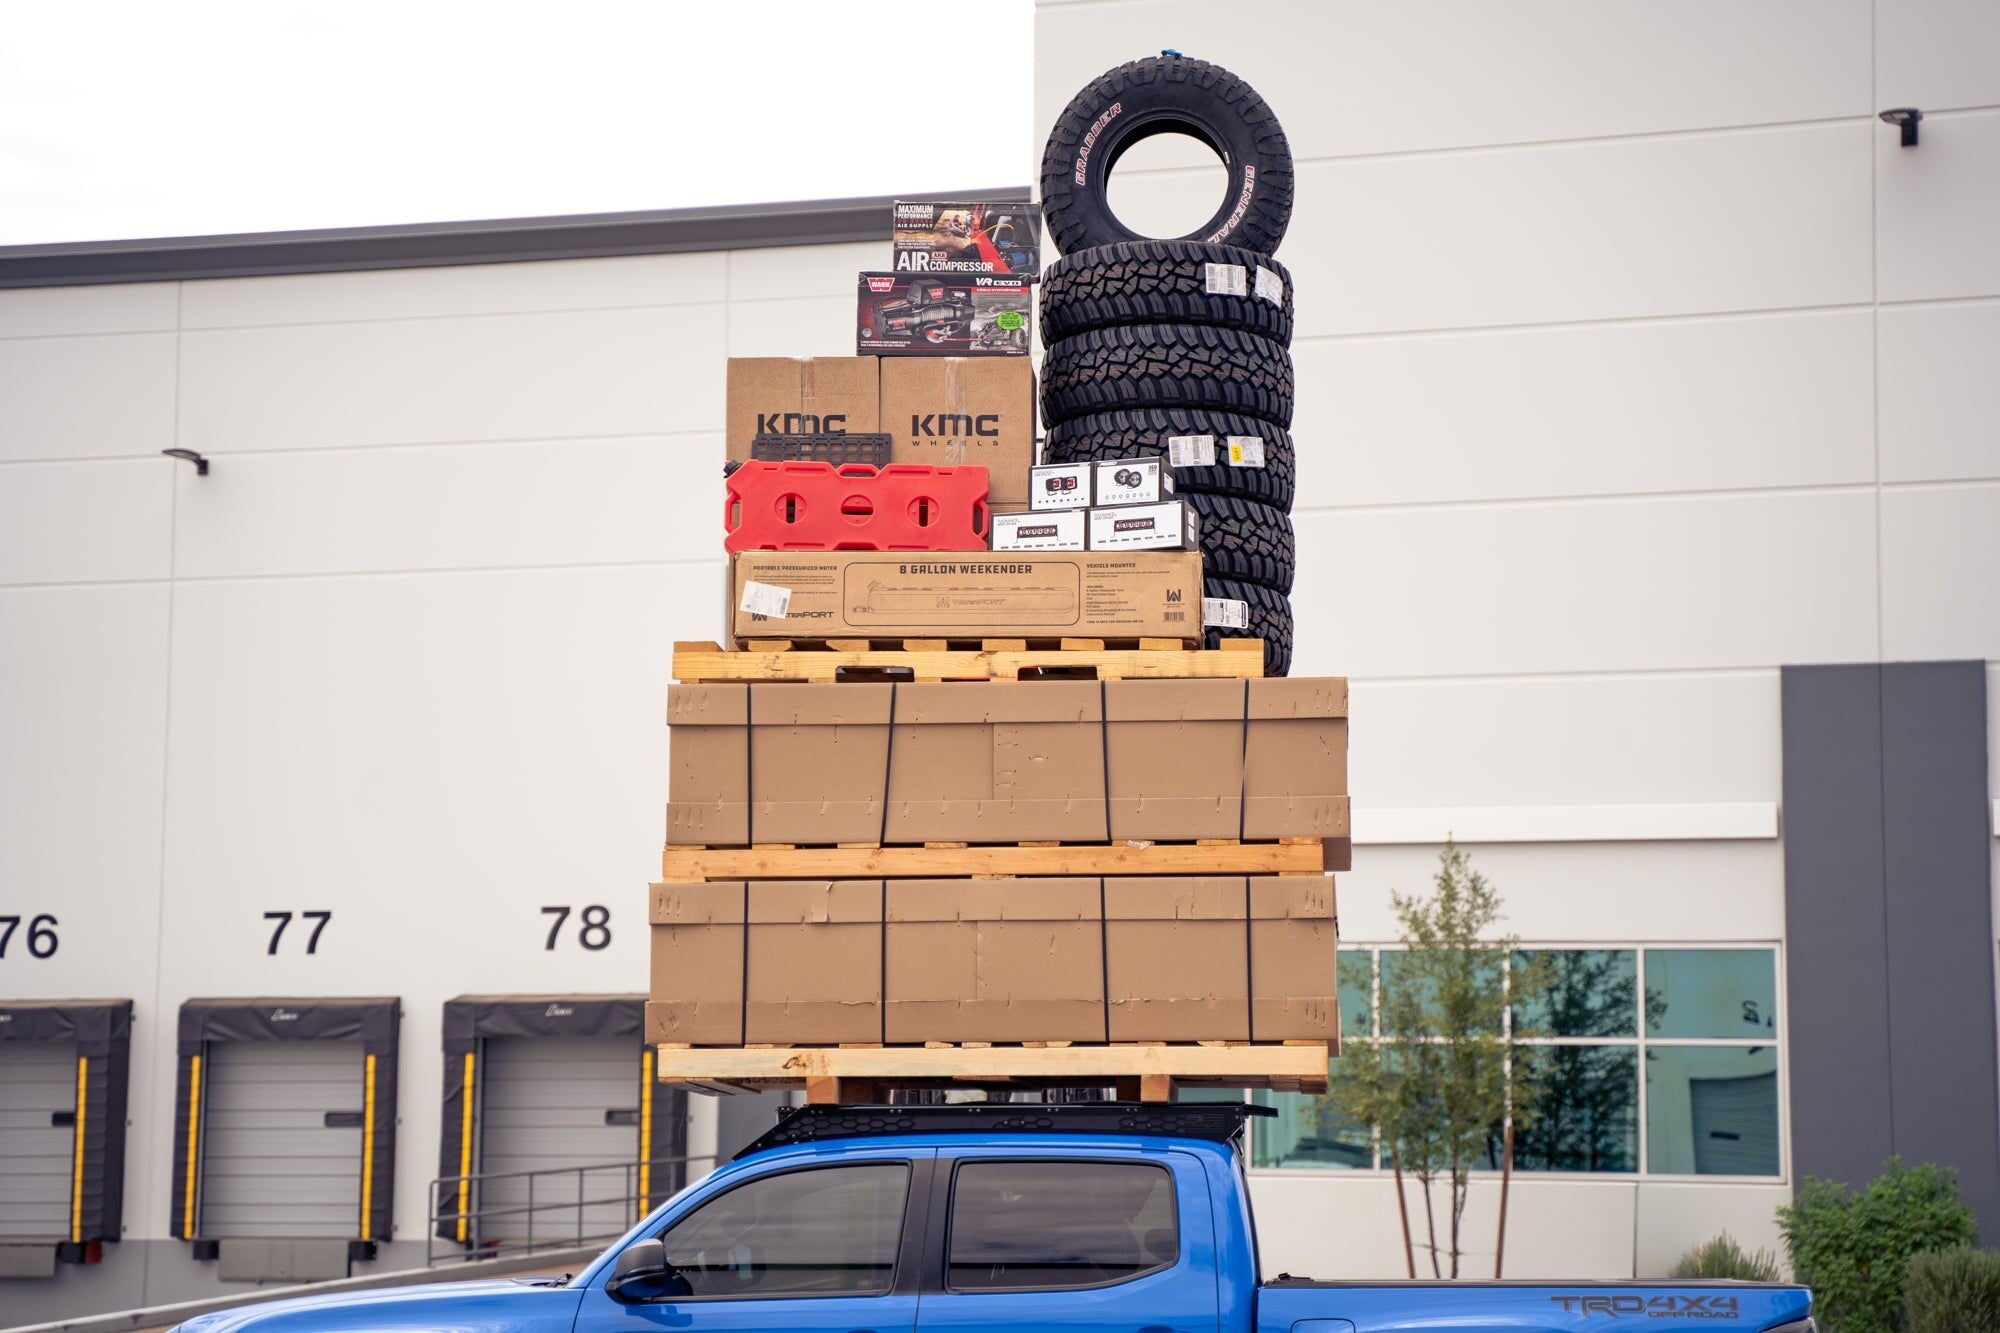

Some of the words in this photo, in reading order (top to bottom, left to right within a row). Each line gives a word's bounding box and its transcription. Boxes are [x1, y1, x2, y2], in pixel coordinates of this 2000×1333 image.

[1075, 103, 1121, 185] GRABBER
[897, 205, 934, 214] MAXIMUM
[1207, 165, 1255, 244] GENERAL
[897, 251, 930, 271] AIR
[930, 261, 994, 272] COMPRESSOR
[976, 277, 993, 286] VR
[899, 565, 907, 574] 8
[911, 565, 956, 574] GALLON
[960, 564, 1032, 574] WEEKENDER
[0, 914, 59, 959] 76
[263, 911, 332, 955] 77
[541, 905, 612, 951] 78
[1550, 1295, 1647, 1318] TRD
[1647, 1295, 1739, 1311] 4X4
